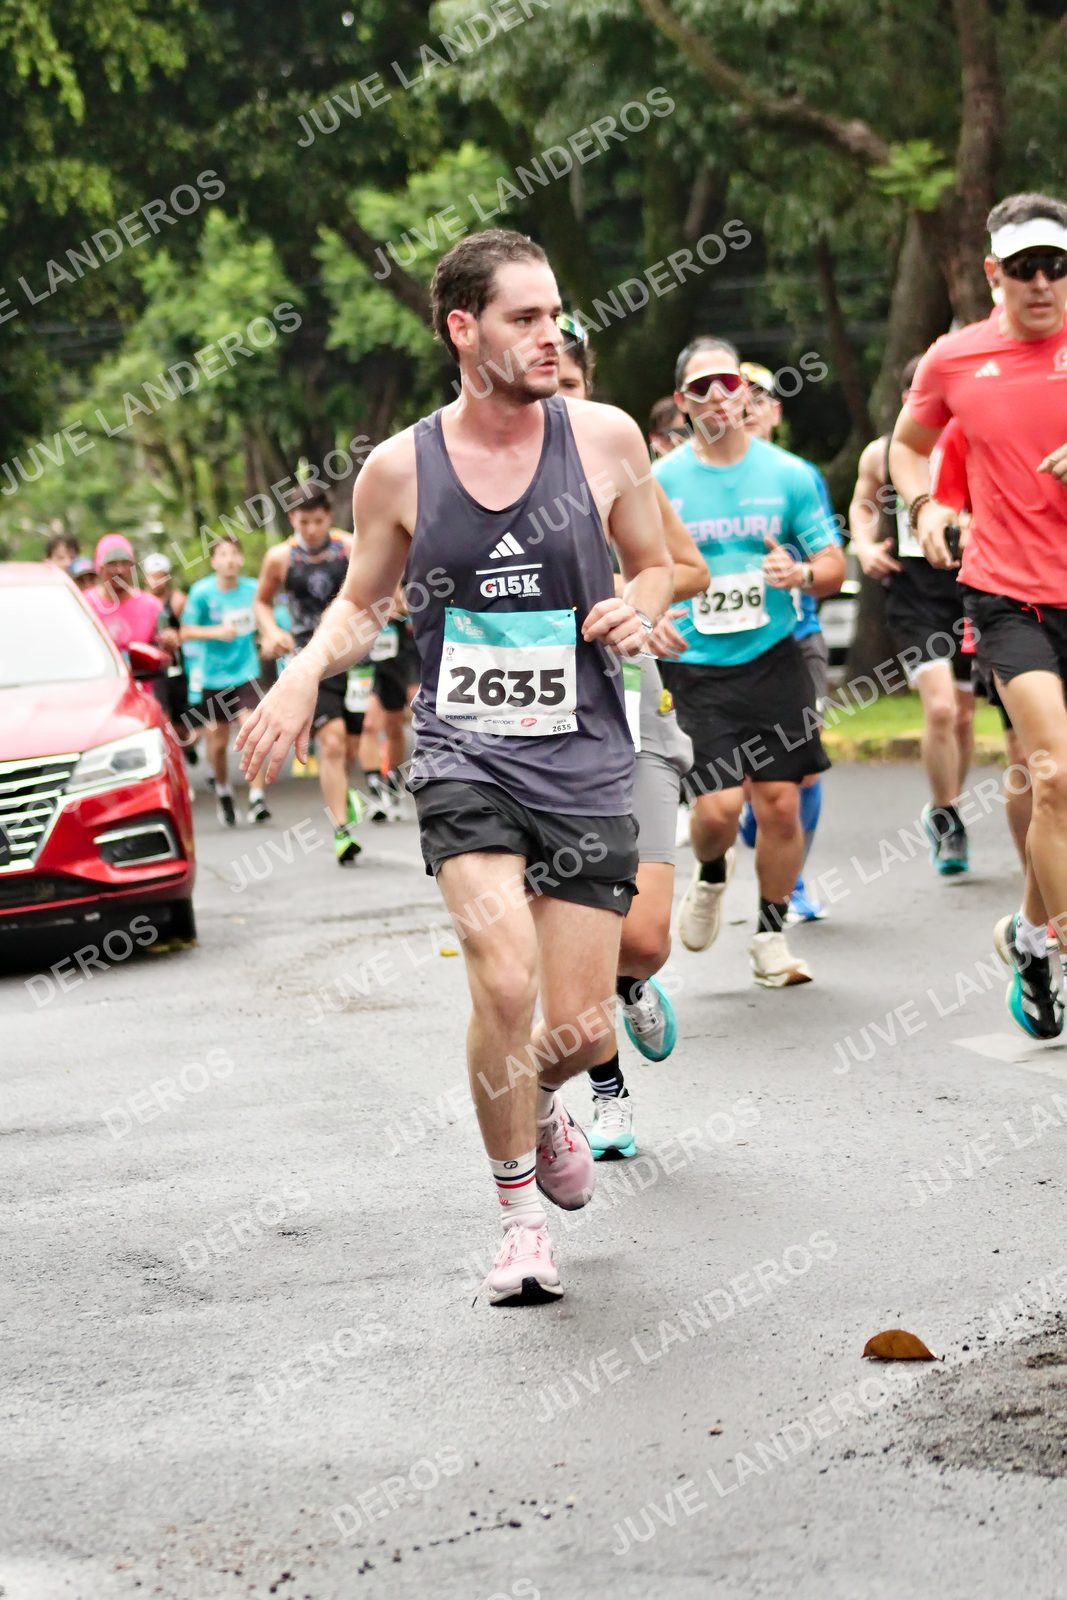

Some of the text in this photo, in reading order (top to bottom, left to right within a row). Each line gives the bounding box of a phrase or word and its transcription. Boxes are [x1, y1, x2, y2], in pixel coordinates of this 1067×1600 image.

[479, 573, 541, 598] G15K
[446, 666, 567, 708] 2635
[552, 724, 571, 732] 2635
